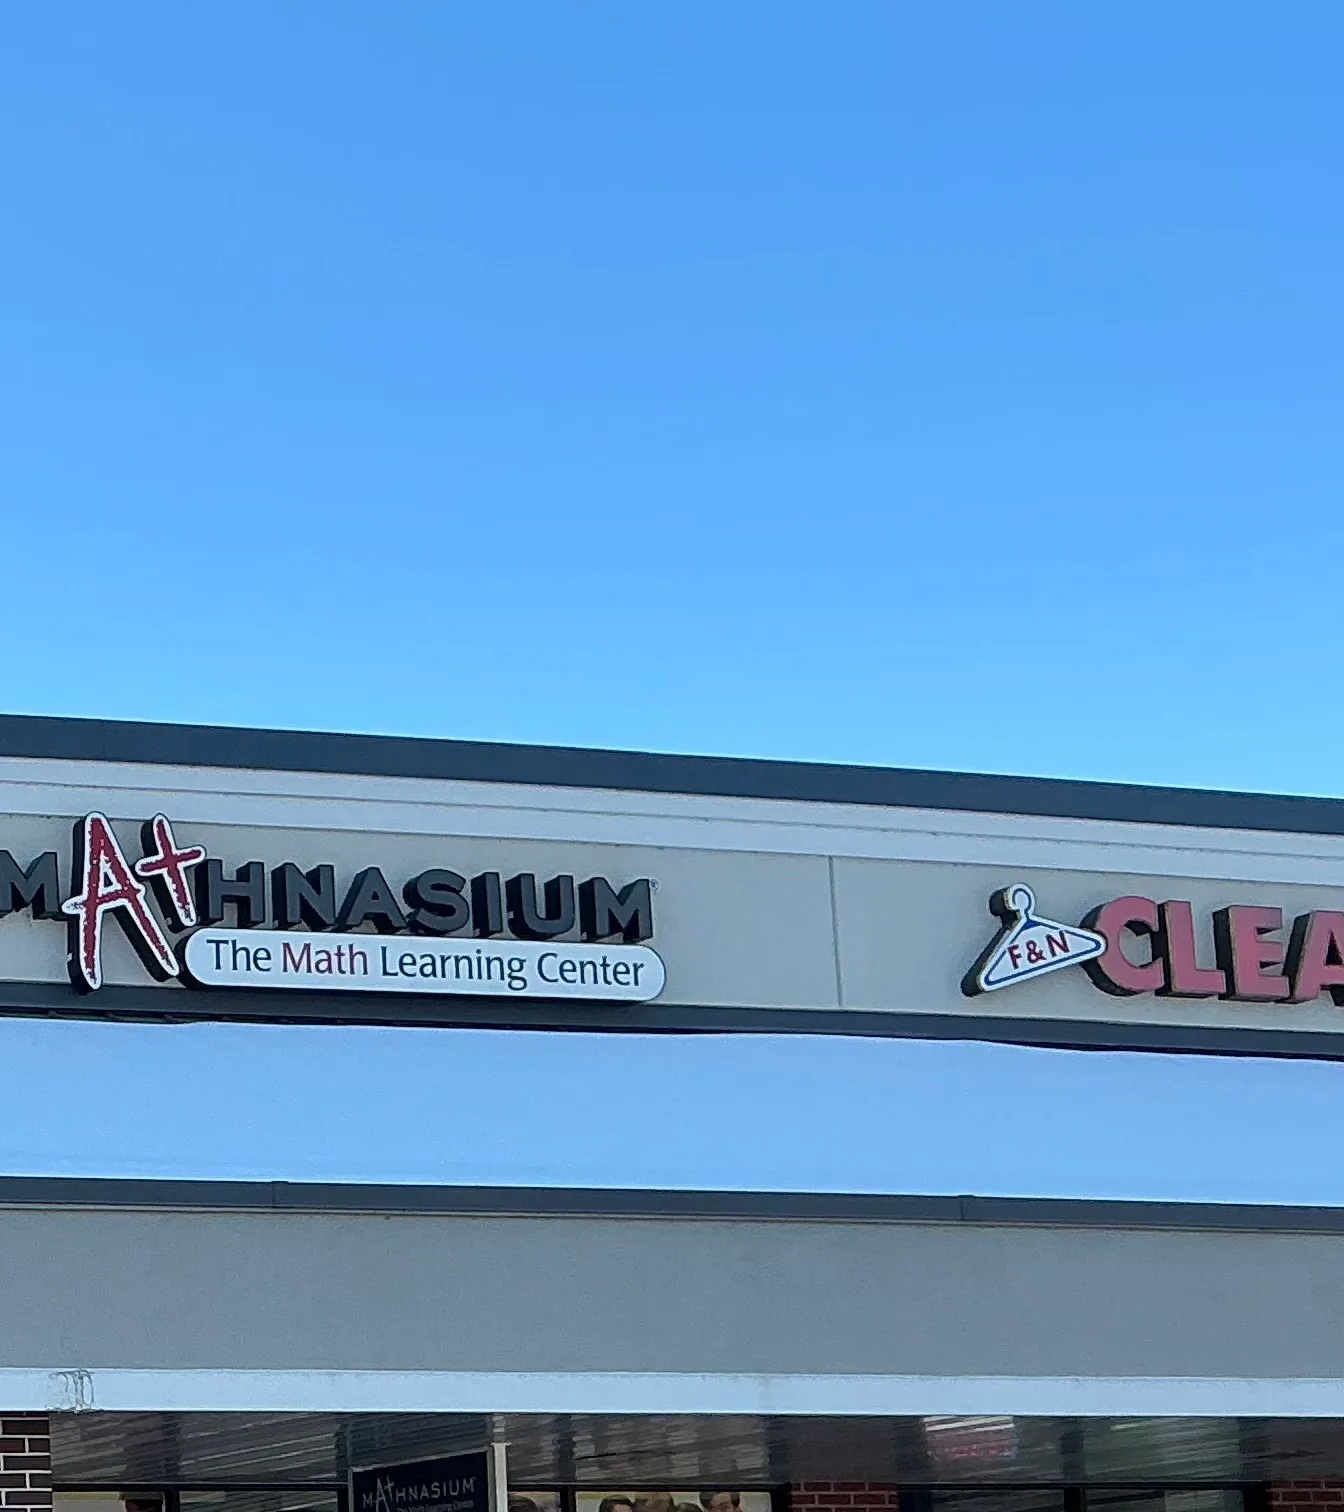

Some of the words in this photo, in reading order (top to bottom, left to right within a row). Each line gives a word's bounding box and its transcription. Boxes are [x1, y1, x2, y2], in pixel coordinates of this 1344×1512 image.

[205, 938, 273, 974] The
[282, 941, 369, 978] Math
[380, 945, 529, 989] Learning
[537, 951, 646, 987] Center
[1007, 929, 1071, 970] F&N
